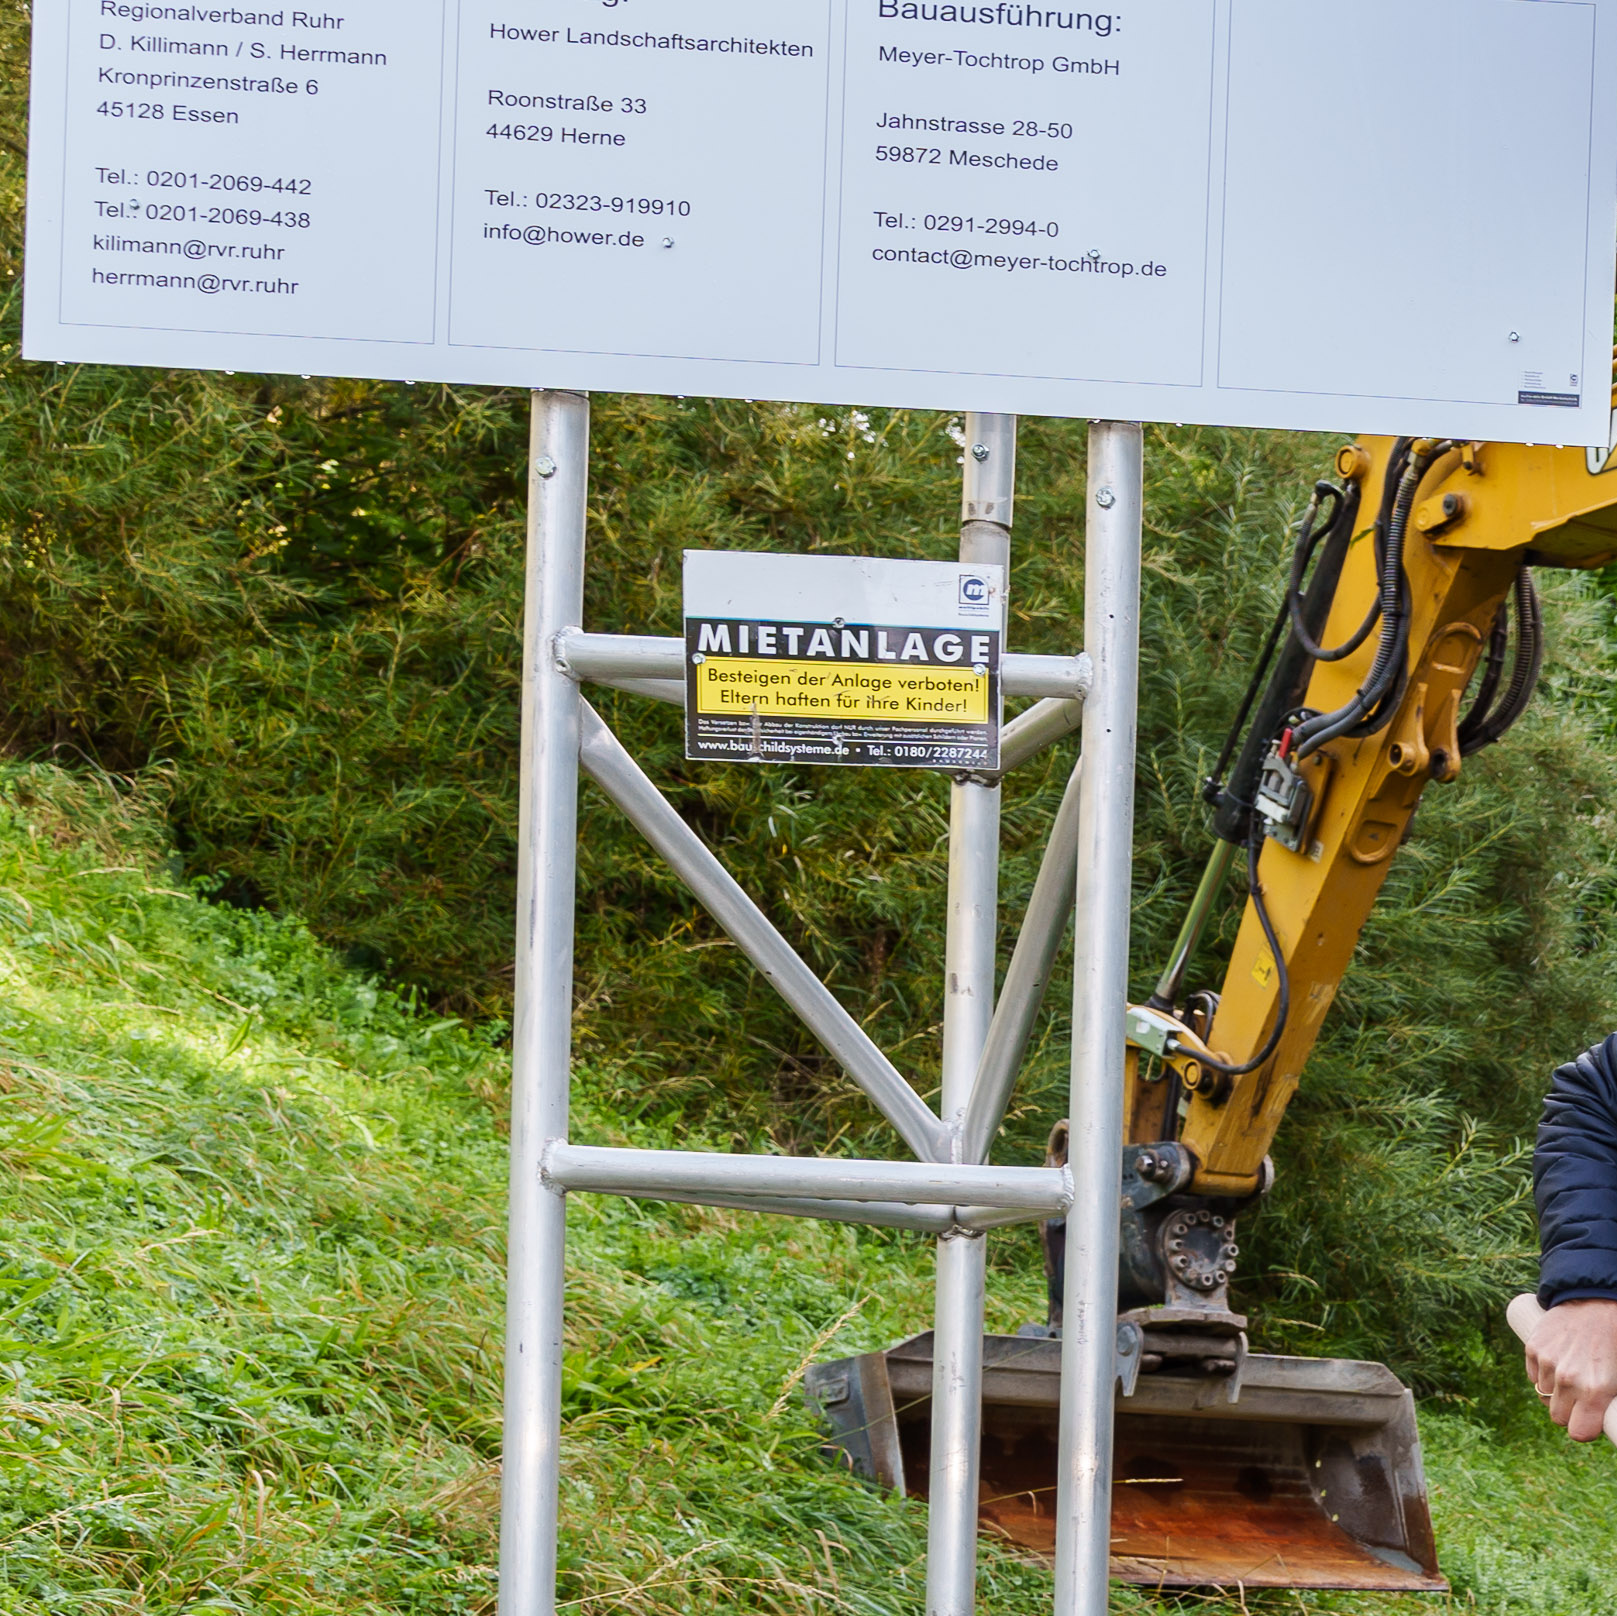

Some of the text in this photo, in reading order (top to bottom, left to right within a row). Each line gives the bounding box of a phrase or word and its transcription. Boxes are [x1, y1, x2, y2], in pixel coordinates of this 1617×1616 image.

[100, 0, 345, 30] Regionalverband Ruhr
[878, 0, 1122, 38] Bauausführung:
[99, 33, 387, 66] D. Killimann / S. Herrmann
[490, 22, 814, 58] Hower Landschaftsarchitekten
[879, 45, 1120, 76] Meyer-Tochtrop GmbH
[98, 66, 319, 96] Kronprinzenstraße 6
[95, 100, 239, 125] 45128 Essen
[488, 89, 647, 115] Roonstraße 33
[485, 123, 626, 147] 44629 Herne
[875, 112, 1073, 140] Jahnstrasse 28-50
[875, 145, 1059, 172] 59872 Meschede
[94, 166, 312, 196] Tel.: 0201-2069-442
[145, 203, 311, 229] 0201-2069-438
[483, 189, 691, 217] Tel.: 02323-919910
[483, 222, 645, 248] info@hower.de
[872, 211, 1059, 238] Tel.: 0291-2994-0
[93, 233, 286, 261] kilimann@rvr.ruhr
[871, 247, 1168, 279] contact@meyer-tochtrop.de
[92, 267, 300, 295] herrmann@rvr.ruhr
[697, 622, 990, 664] MIETANLAGE
[707, 667, 980, 693] Besteigen der Anlage verboten!
[720, 688, 967, 713] Eltern haften für ihre Kinder!
[697, 739, 850, 756] www.bauchildsysteme.de
[866, 744, 891, 757] Tel.:
